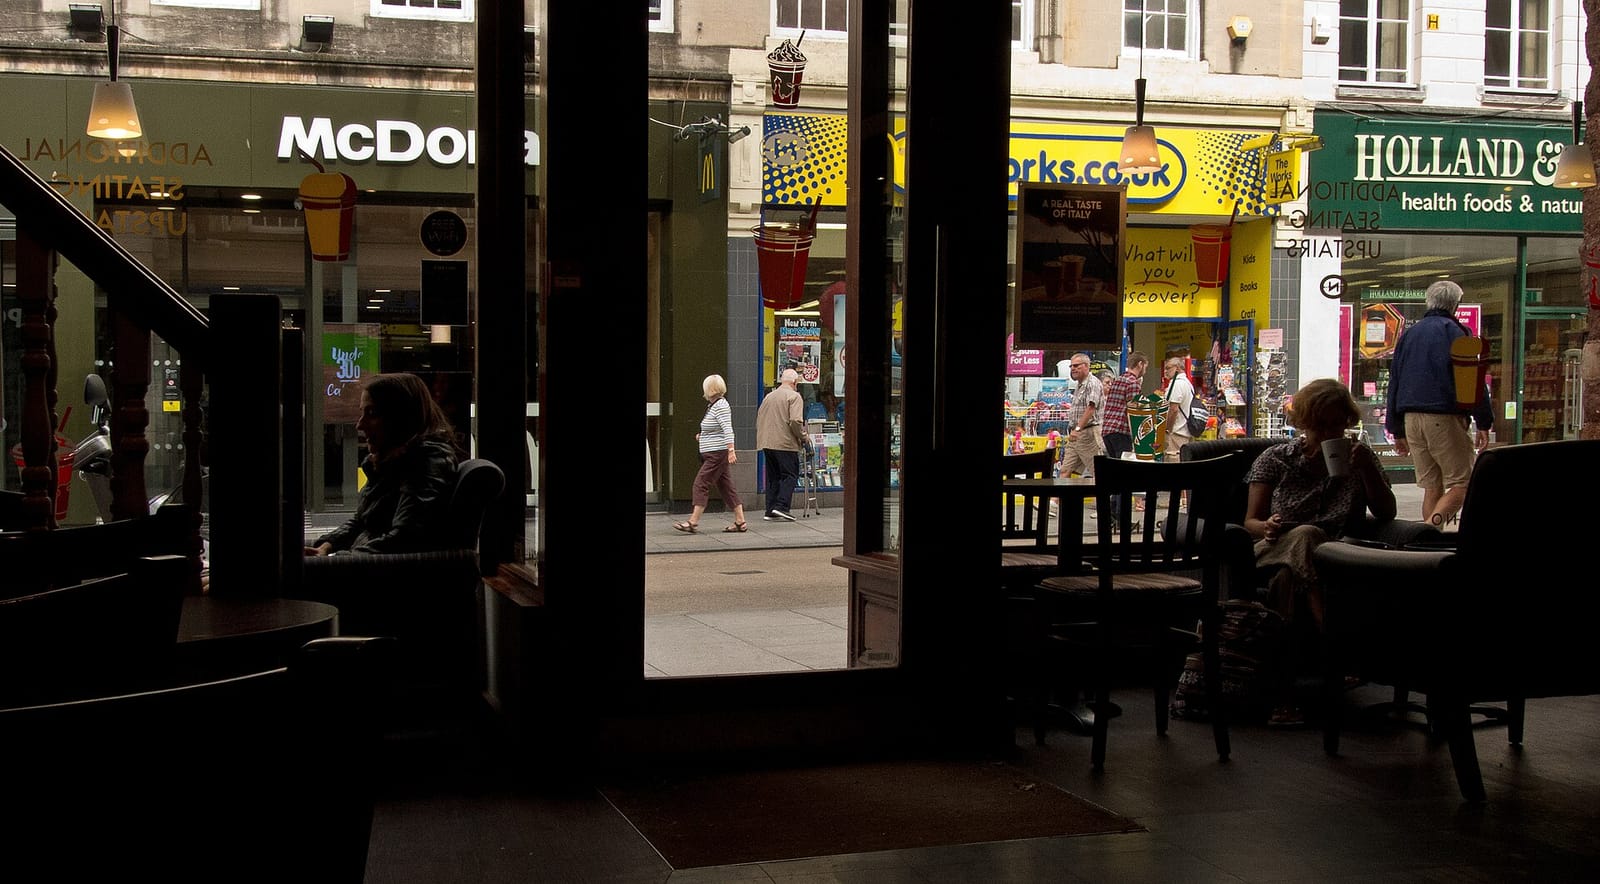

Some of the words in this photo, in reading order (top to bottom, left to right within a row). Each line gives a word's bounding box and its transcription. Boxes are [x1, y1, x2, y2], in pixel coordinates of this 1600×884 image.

[277, 116, 540, 166] McDo
[1275, 158, 1289, 170] The
[1354, 134, 1525, 182] HOLLAND
[1532, 139, 1565, 186] &
[1008, 150, 1171, 187] orks.co.uk
[1270, 170, 1292, 183] Works
[1041, 199, 1049, 208] A
[1050, 199, 1074, 209] REAL
[1075, 200, 1103, 210] TASTE
[1401, 191, 1457, 211] health
[1463, 192, 1513, 212] foods
[1519, 194, 1534, 213] &
[1052, 209, 1067, 218] OF
[1067, 209, 1092, 219] ITALY
[1242, 254, 1256, 265] Kids
[1143, 267, 1176, 286] you
[1240, 283, 1258, 292] Books
[1241, 309, 1256, 320] Craft
[1010, 356, 1023, 365] For
[1023, 356, 1040, 365] Less
